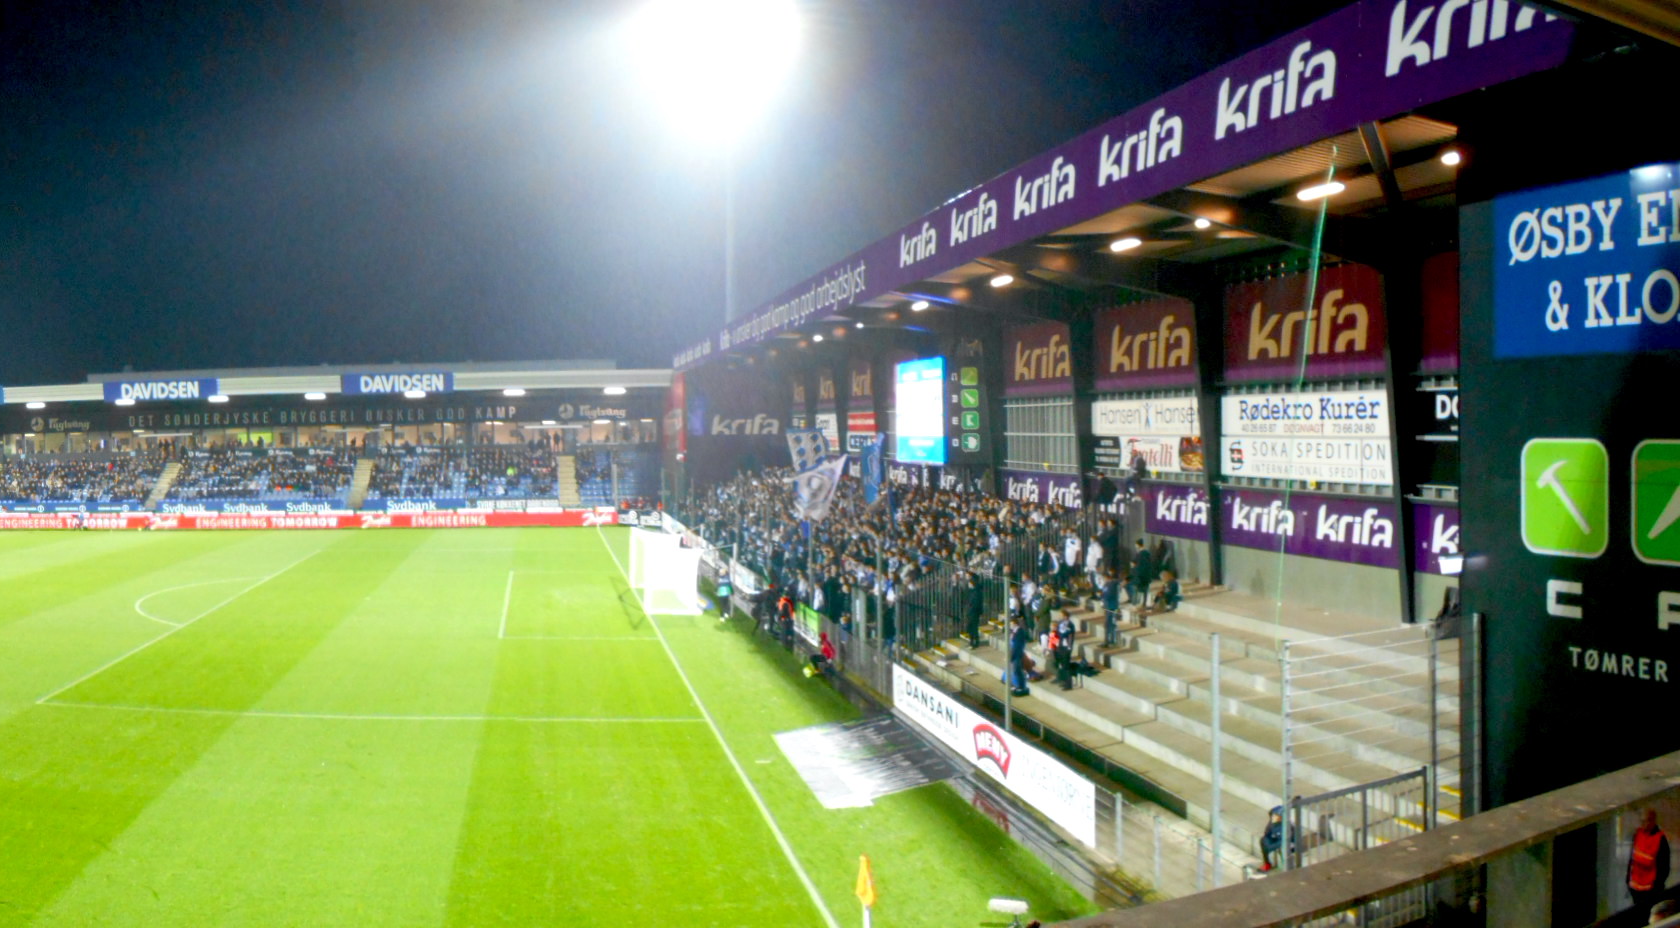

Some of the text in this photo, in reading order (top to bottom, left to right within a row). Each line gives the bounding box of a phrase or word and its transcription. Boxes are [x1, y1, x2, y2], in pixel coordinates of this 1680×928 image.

[1215, 40, 1336, 140] krifa
[1097, 108, 1183, 187] krifa
[1013, 156, 1075, 221] krifa
[950, 191, 997, 247] krifa
[1508, 198, 1622, 266] ØSBY
[899, 221, 937, 268] krifa
[1545, 269, 1680, 331] & KLO
[1248, 290, 1368, 360] krifa
[1015, 334, 1070, 381] krifa
[1110, 316, 1191, 373] krifa
[121, 381, 199, 400] DAVIDSEN
[361, 374, 444, 392] DAVIDSEN
[129, 415, 153, 427] DET
[280, 410, 355, 424] BRYGGERI
[476, 406, 516, 419] KAMP
[711, 414, 779, 435] krifa
[1239, 395, 1380, 421] Rødekro Kurér
[1251, 440, 1386, 460] SOKA SPEDITION
[1008, 477, 1039, 502] krifa
[1329, 466, 1386, 480] SPEDITION
[0, 517, 62, 528] ENGINEERING
[196, 517, 337, 528] ENGINEERING TOMORROW
[411, 516, 486, 526] ENGINEERING
[1156, 491, 1209, 525] krifa
[1232, 497, 1295, 536] krifa
[1316, 504, 1393, 548] krifa
[1569, 646, 1669, 683] TØMRER
[905, 680, 959, 728] DANSANI
